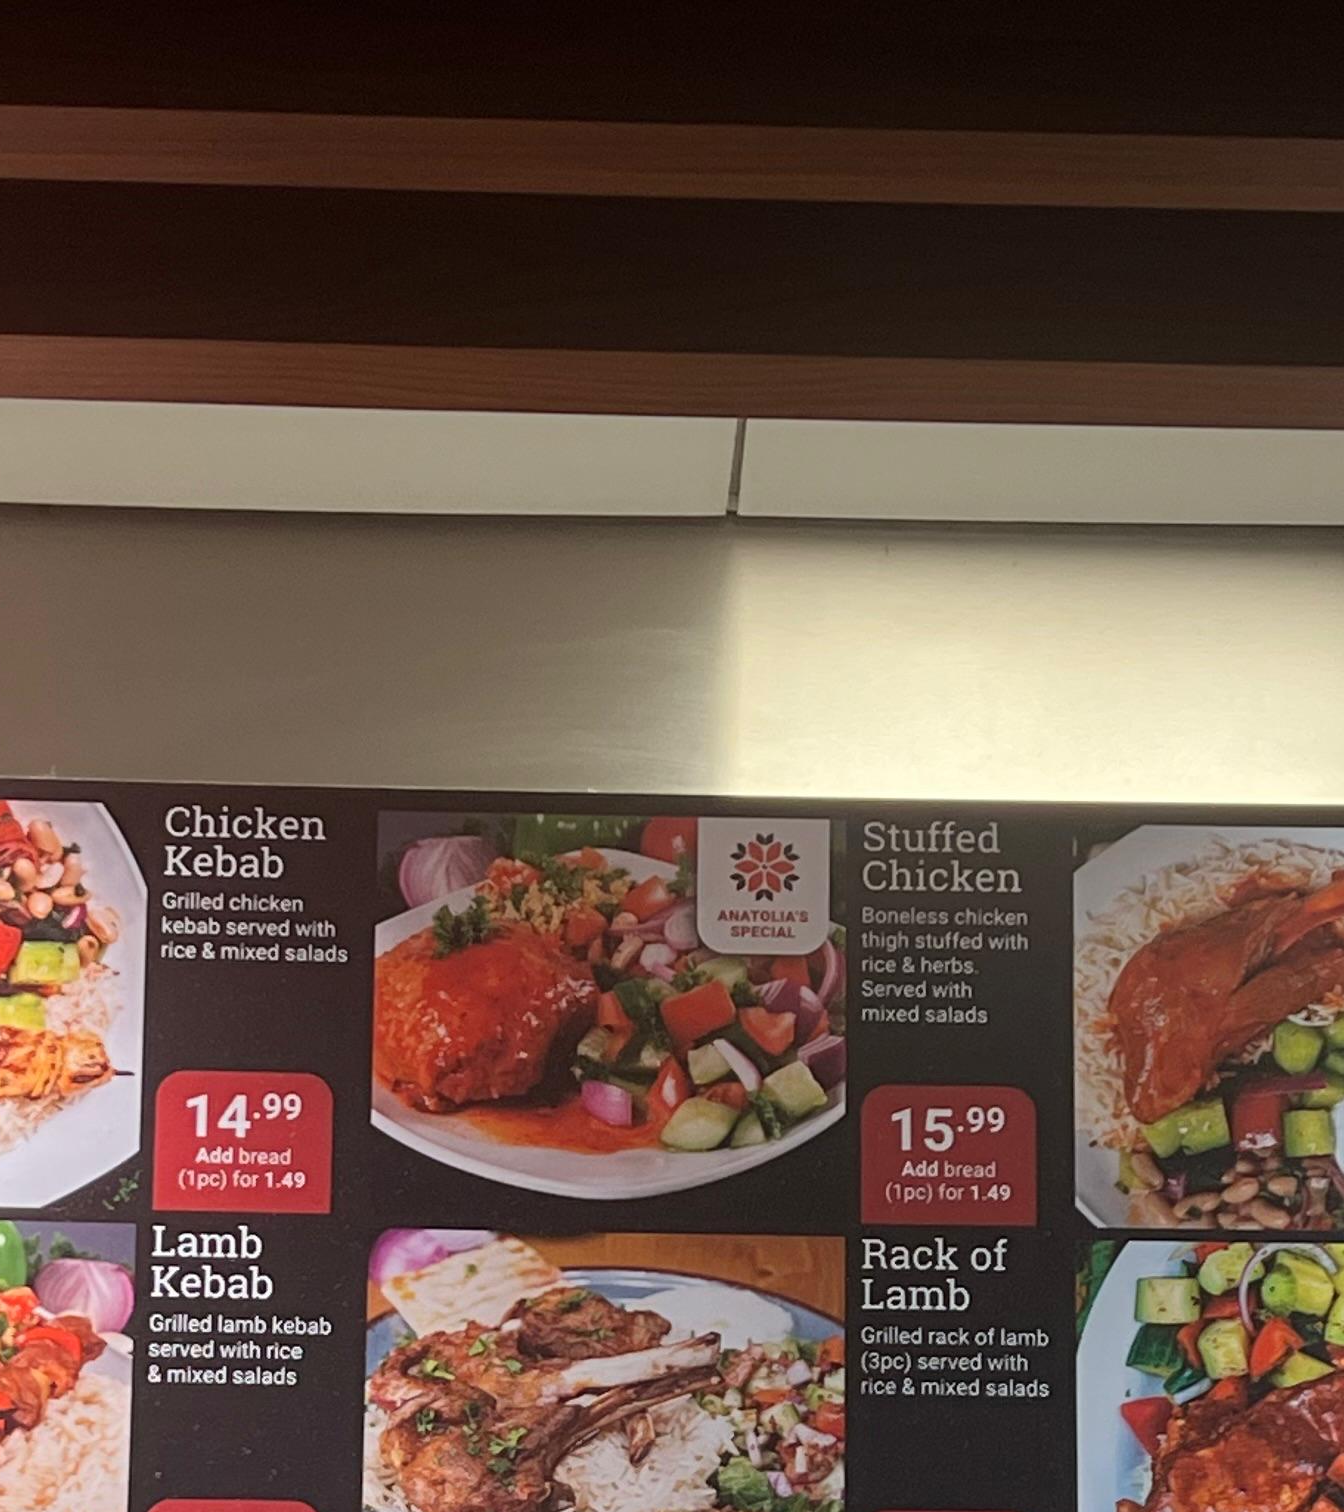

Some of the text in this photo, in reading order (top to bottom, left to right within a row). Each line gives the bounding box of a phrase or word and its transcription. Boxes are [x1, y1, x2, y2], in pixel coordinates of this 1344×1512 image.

[165, 805, 327, 841] Chicken
[863, 820, 1001, 854] Stuffed
[163, 844, 284, 879] Kebab
[862, 858, 1023, 893] Chicken
[162, 891, 304, 913] Grilled chicken
[717, 910, 808, 922] ANATOLIA'S
[161, 915, 336, 938] kebab served with
[731, 926, 795, 938] SPECIAL
[160, 940, 348, 963] rice & mixed salads
[186, 1092, 302, 1139] 14.99
[891, 1106, 1005, 1152] 15.99
[194, 1146, 292, 1165] Add bread
[178, 1168, 306, 1191] (1pc) for 1.49
[151, 1225, 263, 1259] Lamb
[861, 1237, 1008, 1272] Rack of
[150, 1264, 273, 1300] Kebab
[861, 1277, 970, 1311] Lamb
[860, 1325, 1050, 1347] Grilled rack of lamb
[860, 1350, 1029, 1374] (3pc) served with
[860, 1377, 1050, 1398] rice & mixed salads
